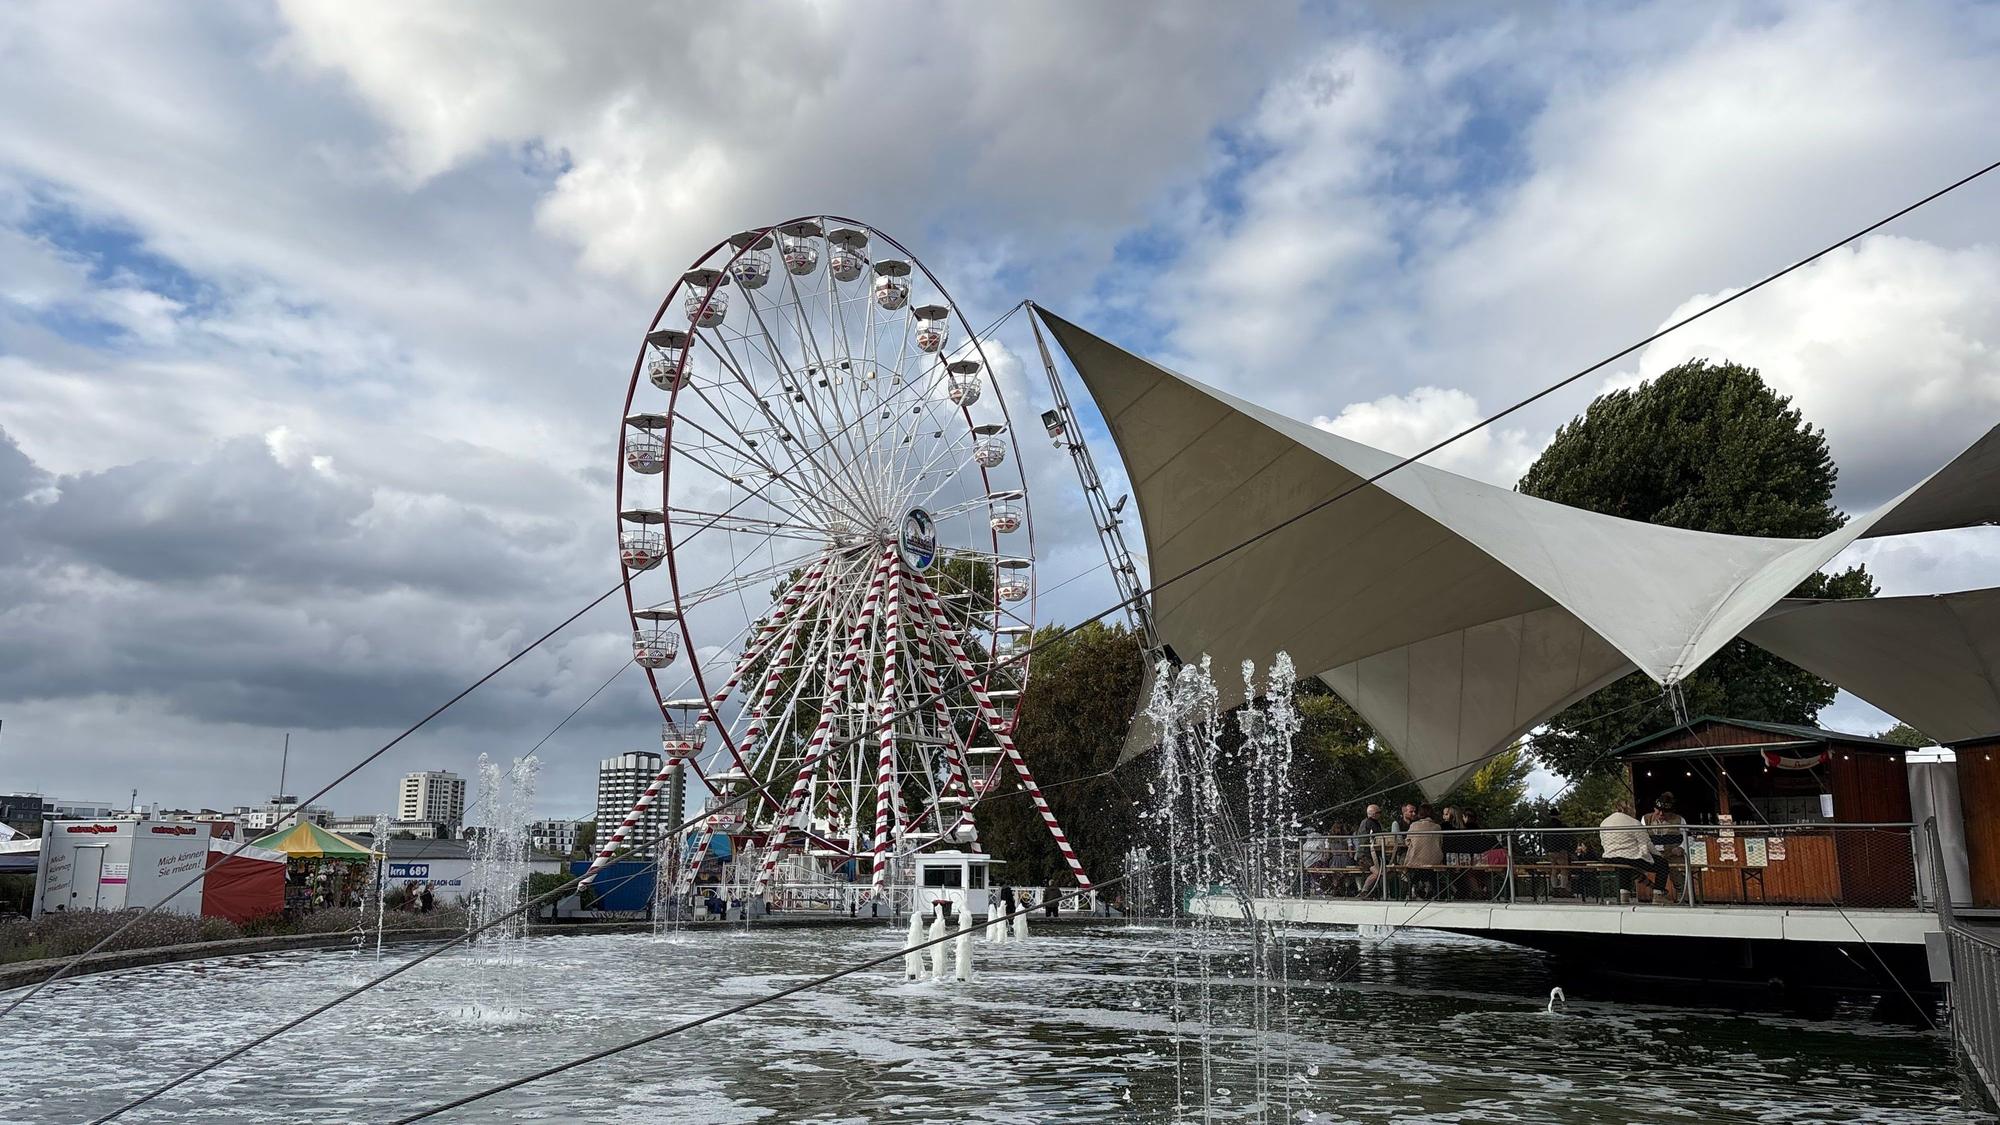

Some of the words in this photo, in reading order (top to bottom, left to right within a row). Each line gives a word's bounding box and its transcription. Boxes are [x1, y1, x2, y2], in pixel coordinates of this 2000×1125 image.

[158, 856, 176, 867] Mich
[178, 850, 204, 862] können
[158, 867, 170, 877] Sie
[172, 859, 201, 874] mieten!
[390, 866, 406, 876] km
[409, 866, 428, 876] 689
